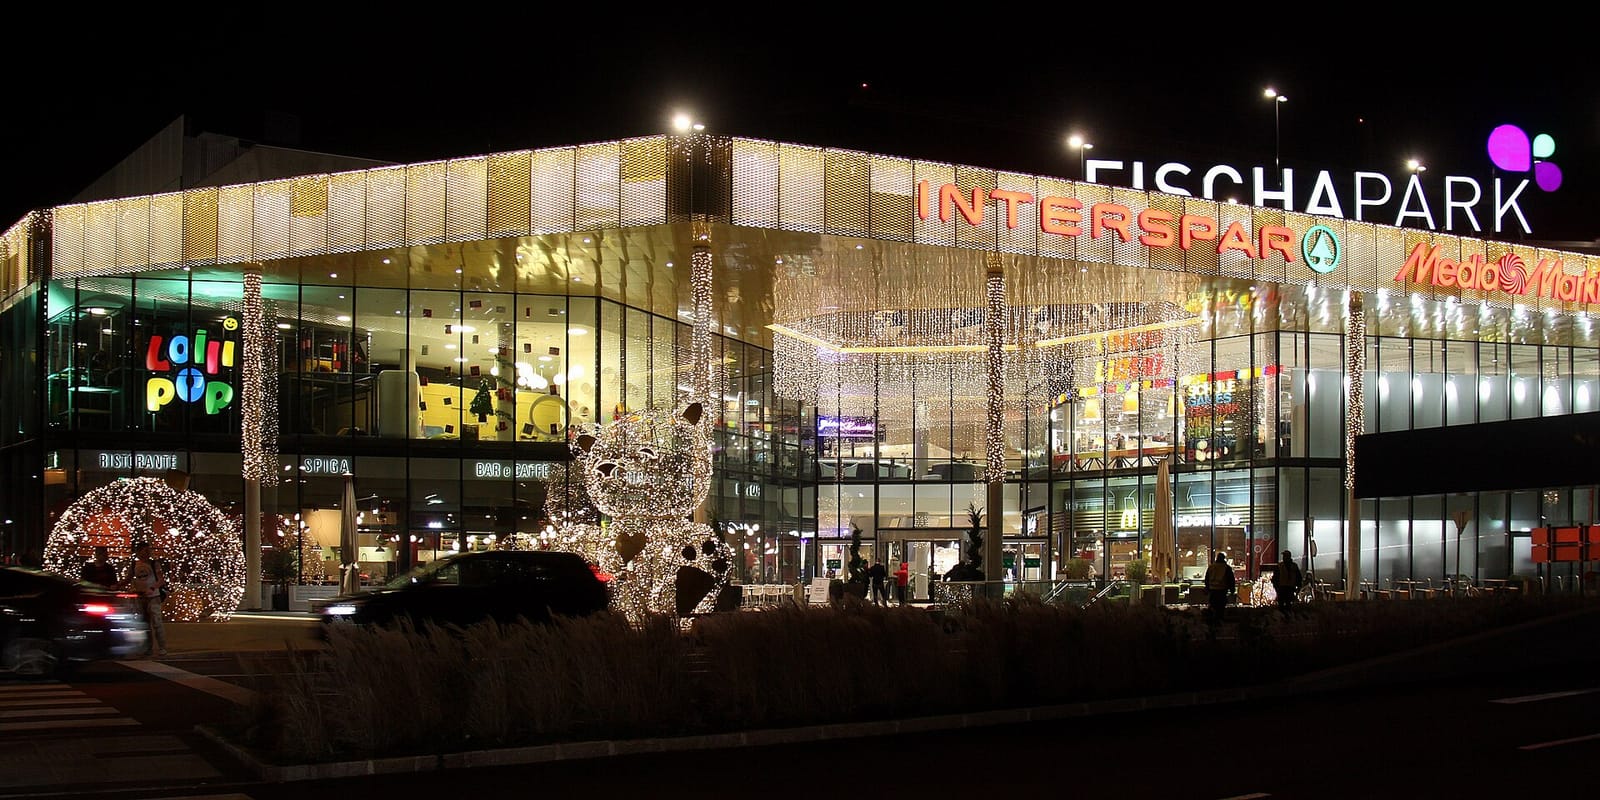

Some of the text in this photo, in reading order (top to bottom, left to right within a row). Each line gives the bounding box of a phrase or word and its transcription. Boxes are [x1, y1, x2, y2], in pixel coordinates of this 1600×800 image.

[918, 179, 1297, 262] INTERSPAR
[304, 458, 350, 474] SPIGA
[475, 462, 501, 478] BAR
